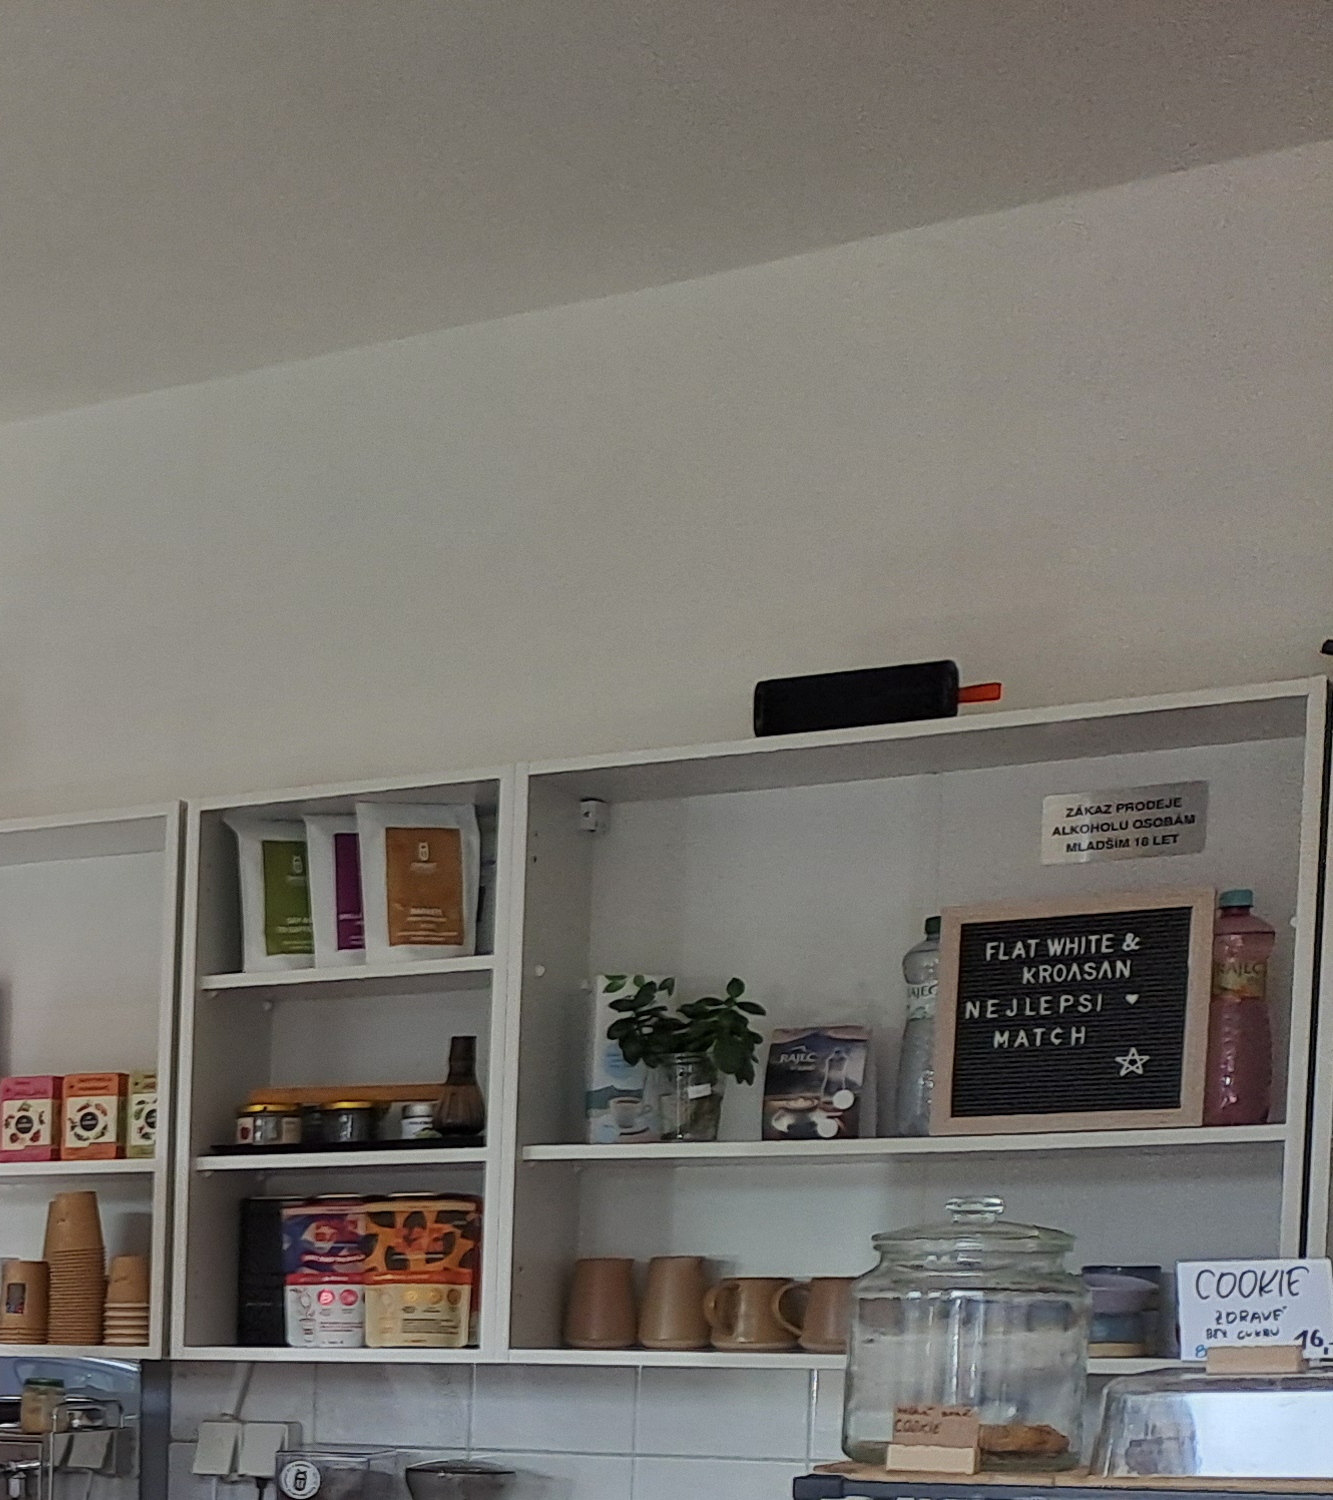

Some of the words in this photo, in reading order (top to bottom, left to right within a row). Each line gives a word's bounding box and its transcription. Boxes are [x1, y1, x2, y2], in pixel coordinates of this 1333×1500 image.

[1065, 804, 1112, 818] ZÁKAZ
[1116, 797, 1182, 813] PRODEJE
[1052, 820, 1129, 836] ALKOHOLU
[1132, 814, 1196, 830] OSOBÁM
[1135, 836, 1149, 847] 18
[1153, 834, 1179, 846] LET
[985, 939, 1040, 961] FLAT
[1047, 934, 1115, 957] WHITE
[1122, 933, 1141, 951] &
[1023, 959, 1132, 985] KROASAN
[964, 993, 1103, 1020] NEJLEPSI
[993, 1026, 1086, 1049] MATCH
[1195, 1266, 1310, 1300] COOKIE
